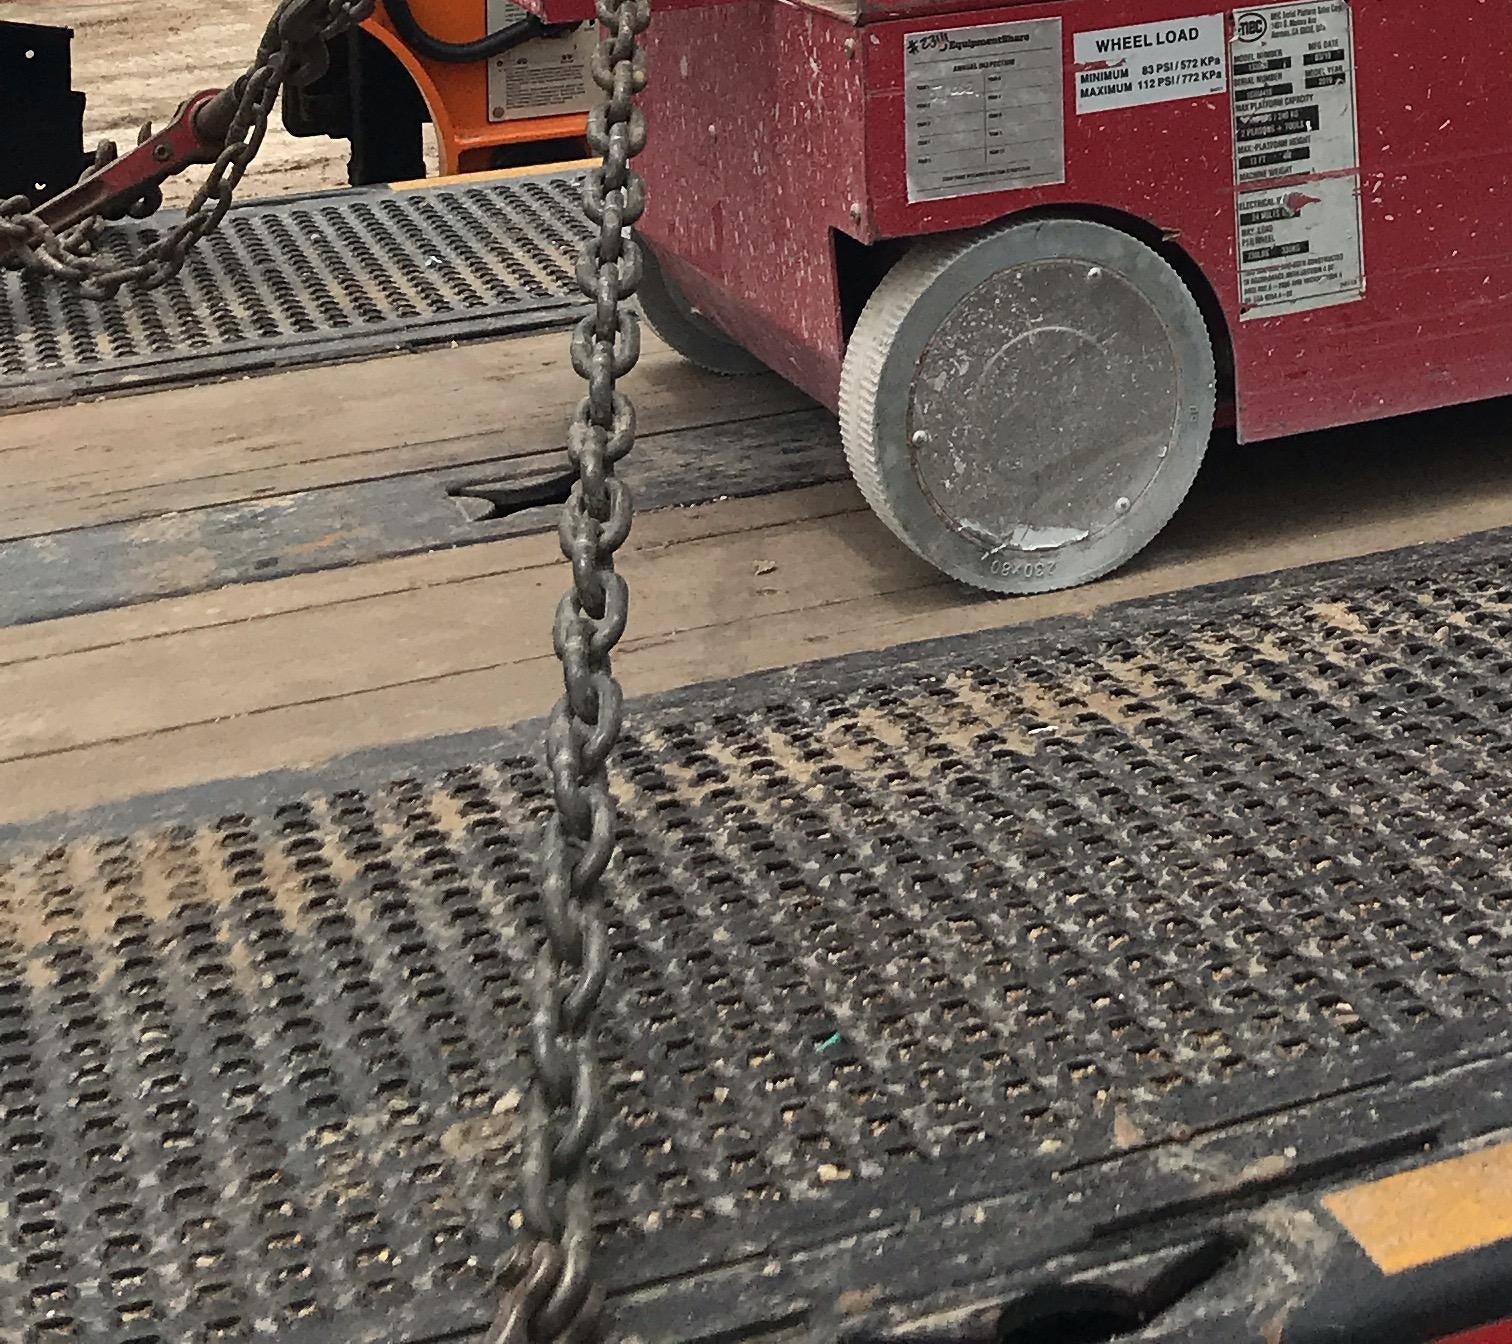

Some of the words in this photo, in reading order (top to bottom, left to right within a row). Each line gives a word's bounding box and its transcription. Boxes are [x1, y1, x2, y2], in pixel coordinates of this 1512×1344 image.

[1096, 34, 1153, 53] WHEEL
[1156, 27, 1199, 46] LOAD
[1080, 68, 1129, 84] MINIMUM
[1142, 65, 1154, 76] 83
[1156, 62, 1174, 73] PSI
[1180, 59, 1198, 70] 572
[1200, 56, 1221, 67] KPa
[1080, 82, 1133, 98] MAXIMUM
[1138, 79, 1156, 90] 112
[1157, 76, 1175, 87] PSI
[1181, 72, 1200, 84] 772
[1202, 70, 1222, 81] KPa
